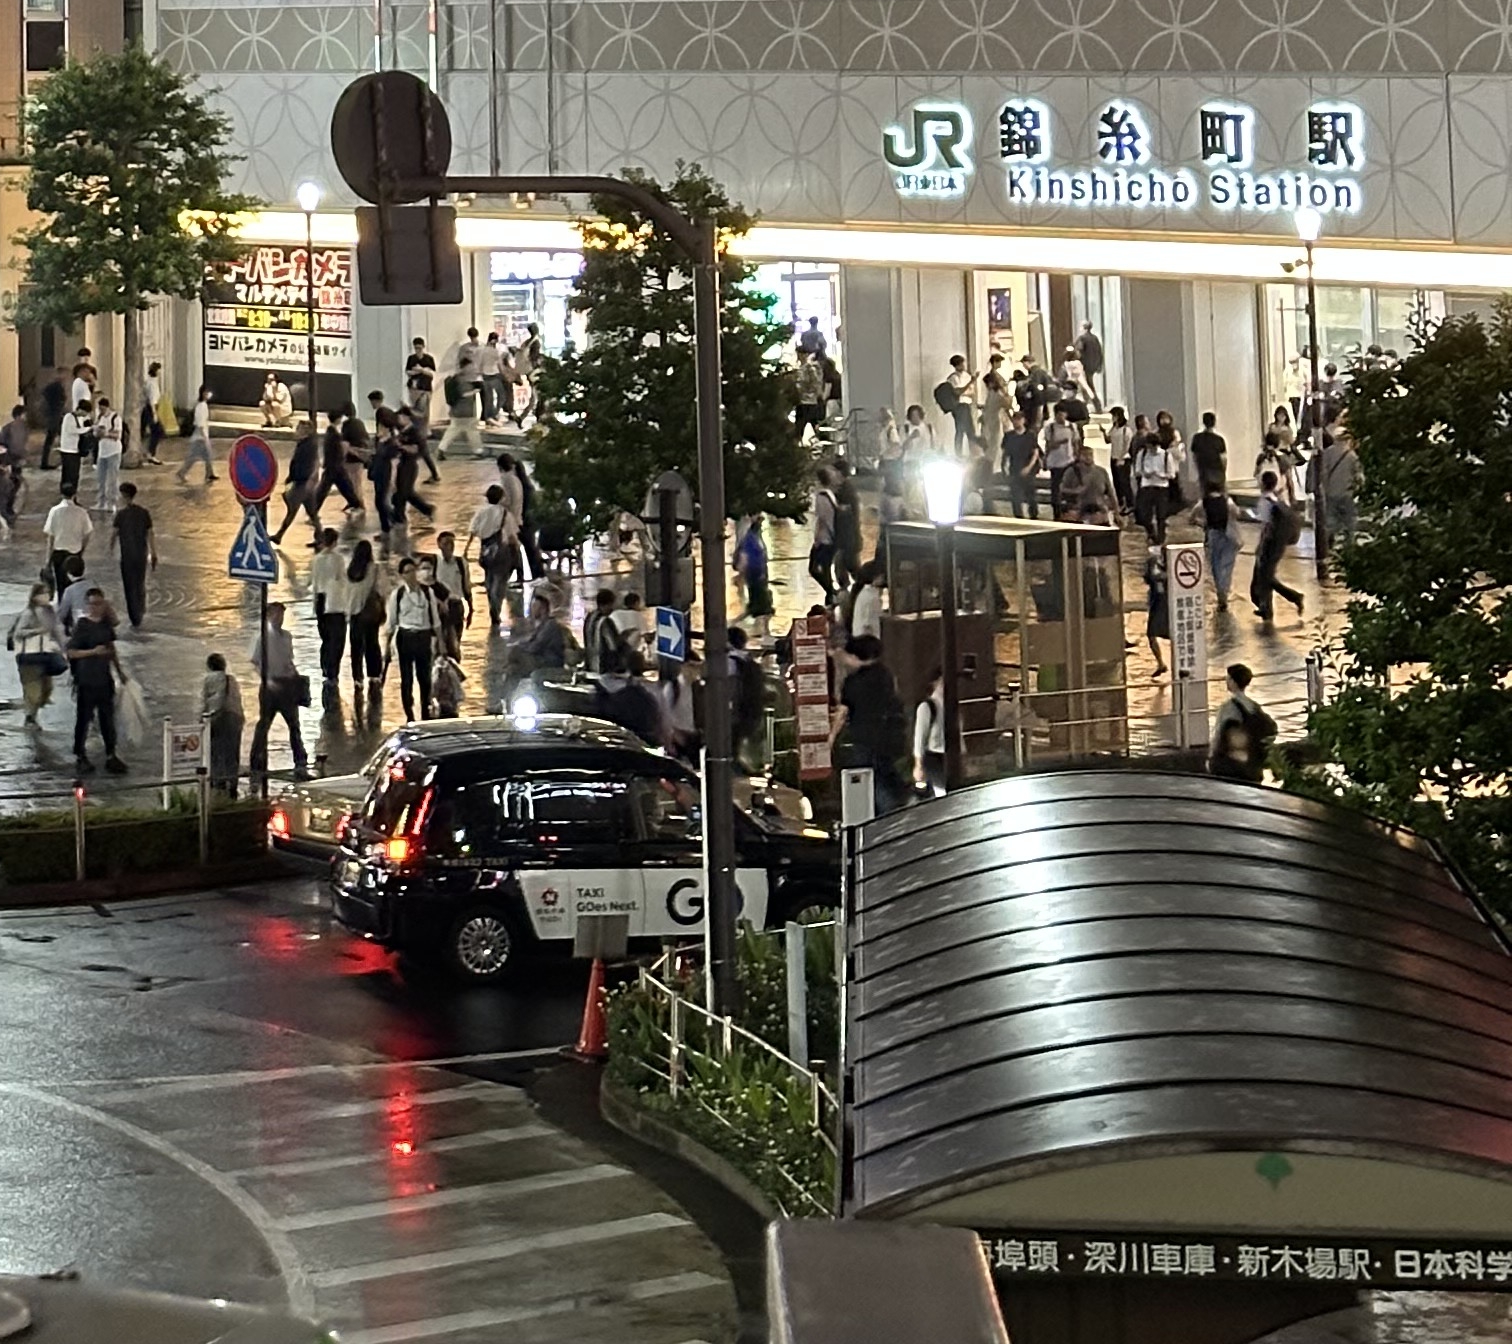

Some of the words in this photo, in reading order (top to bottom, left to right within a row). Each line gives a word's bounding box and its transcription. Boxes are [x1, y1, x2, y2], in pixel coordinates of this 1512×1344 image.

[883, 109, 965, 169] JR
[999, 105, 1355, 167] 錦糸町駅
[1210, 174, 1355, 209] Station
[576, 887, 606, 898] TAXI
